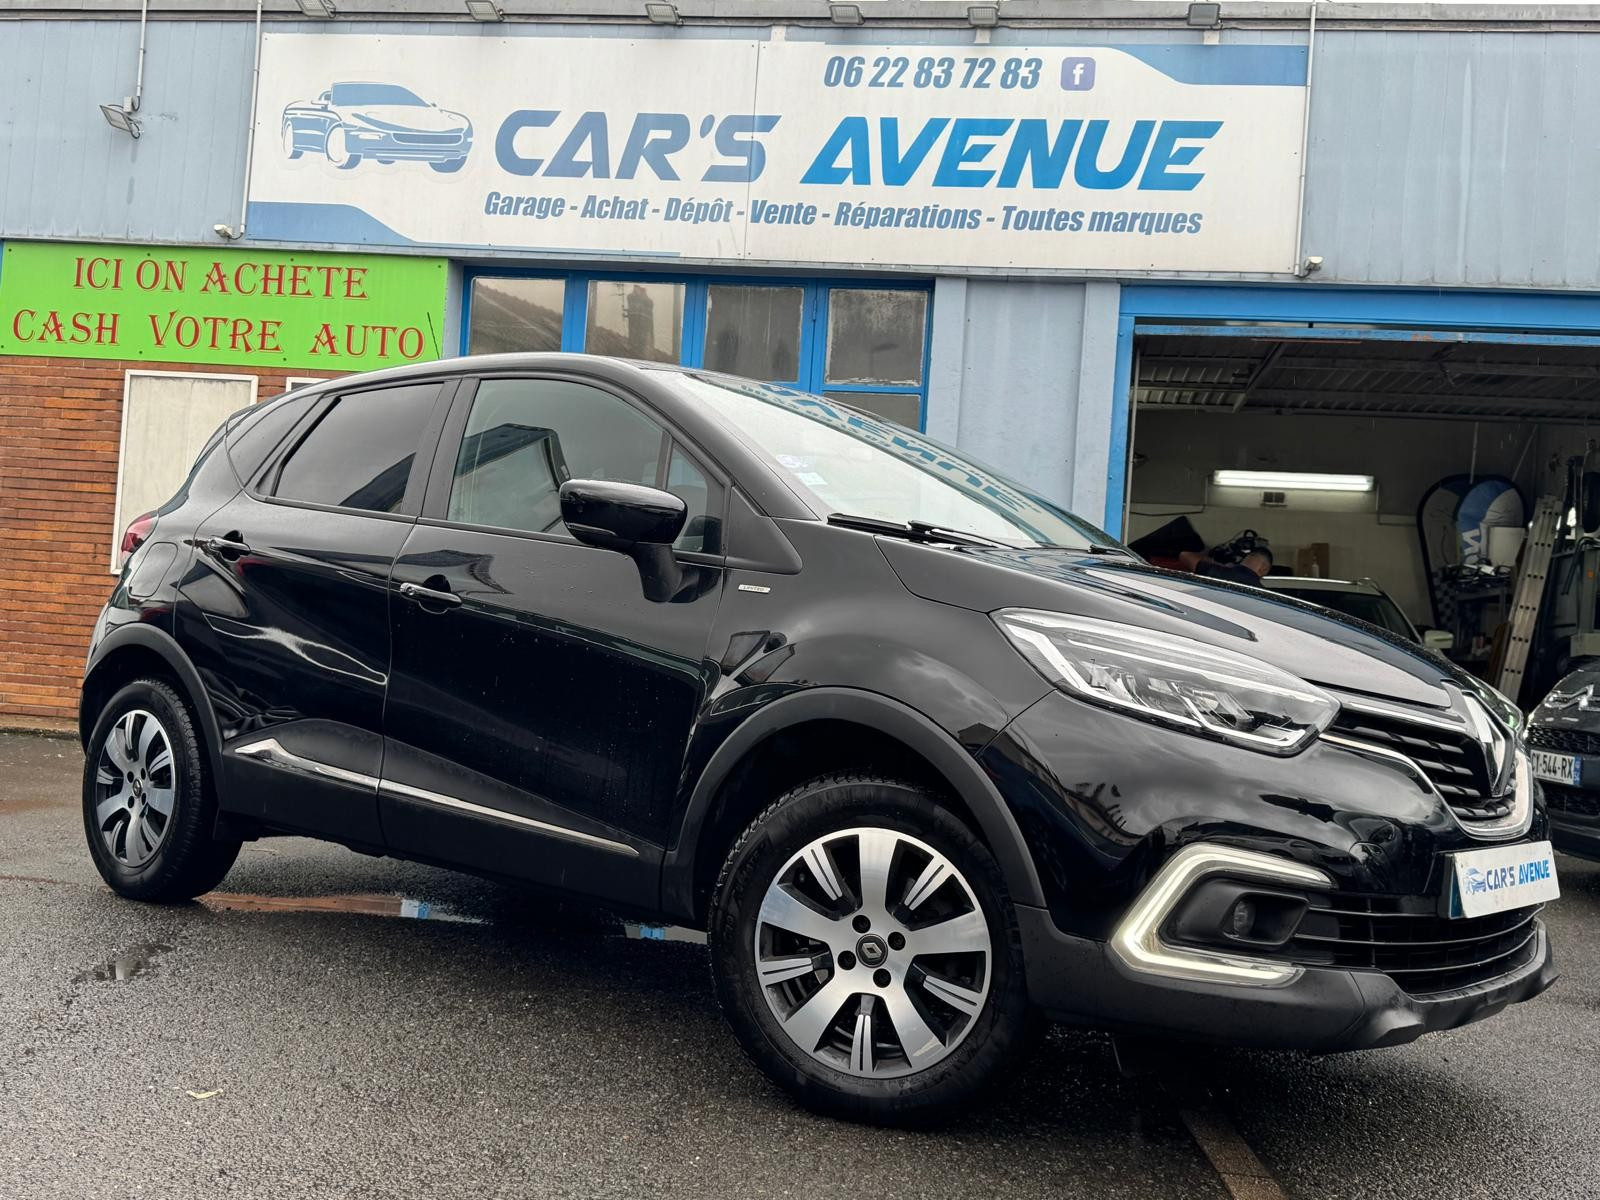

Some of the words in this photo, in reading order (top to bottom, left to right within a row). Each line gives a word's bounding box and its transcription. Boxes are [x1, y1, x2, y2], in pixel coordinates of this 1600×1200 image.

[823, 56, 865, 88] 06
[868, 56, 909, 88] 22
[913, 57, 955, 89] 83
[960, 58, 996, 89] 72
[1000, 57, 1043, 89] 83
[495, 110, 782, 182] CAR'S
[800, 116, 1224, 191] AVENUE
[484, 191, 565, 219] Garage
[581, 195, 649, 220] Achat
[664, 197, 733, 224] Dépôt
[750, 200, 817, 226] Vente
[834, 202, 982, 230] Réparations
[1002, 205, 1084, 232] Toutes
[1088, 210, 1203, 235] marques
[73, 257, 124, 290] ICI
[136, 259, 188, 292] ON
[200, 262, 368, 300] ACHETE
[12, 309, 120, 346] CASH
[149, 309, 283, 353] VOTRE
[309, 323, 425, 359] AUTO
[1486, 866, 1515, 890] CAR'S
[1519, 859, 1550, 885] AVENUE
